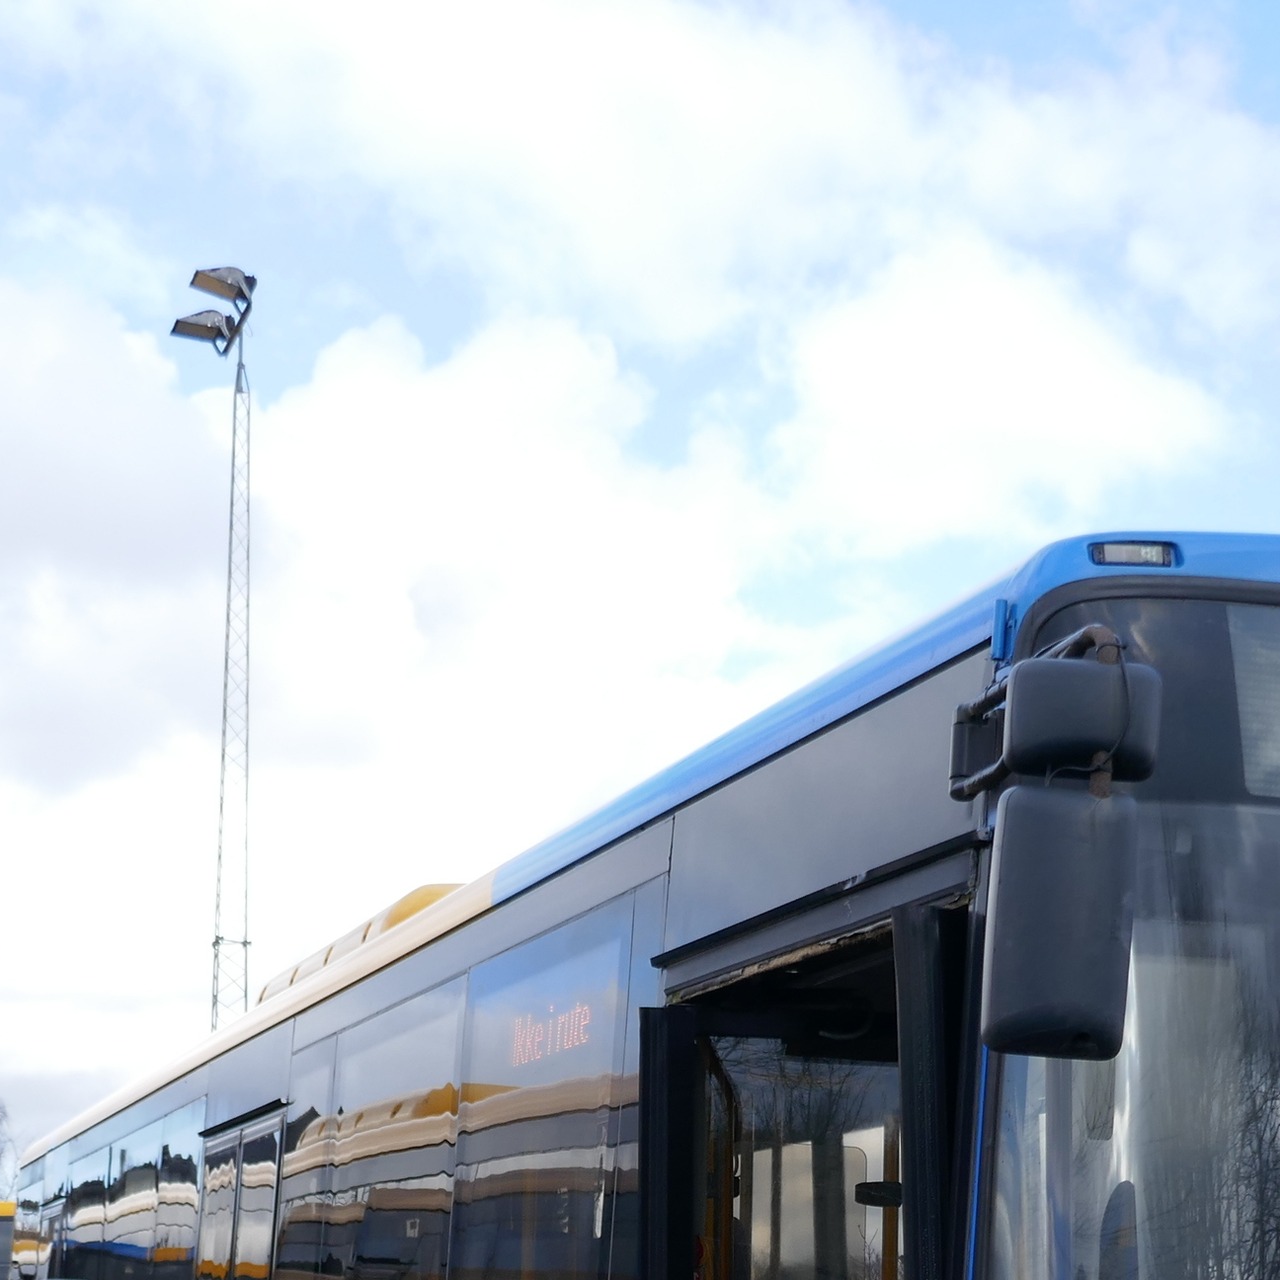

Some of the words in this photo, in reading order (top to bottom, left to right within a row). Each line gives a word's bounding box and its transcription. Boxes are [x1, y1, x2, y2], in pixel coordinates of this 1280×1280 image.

[512, 1013, 544, 1067] Ikke
[546, 1005, 554, 1055] i
[556, 1002, 590, 1052] rute
